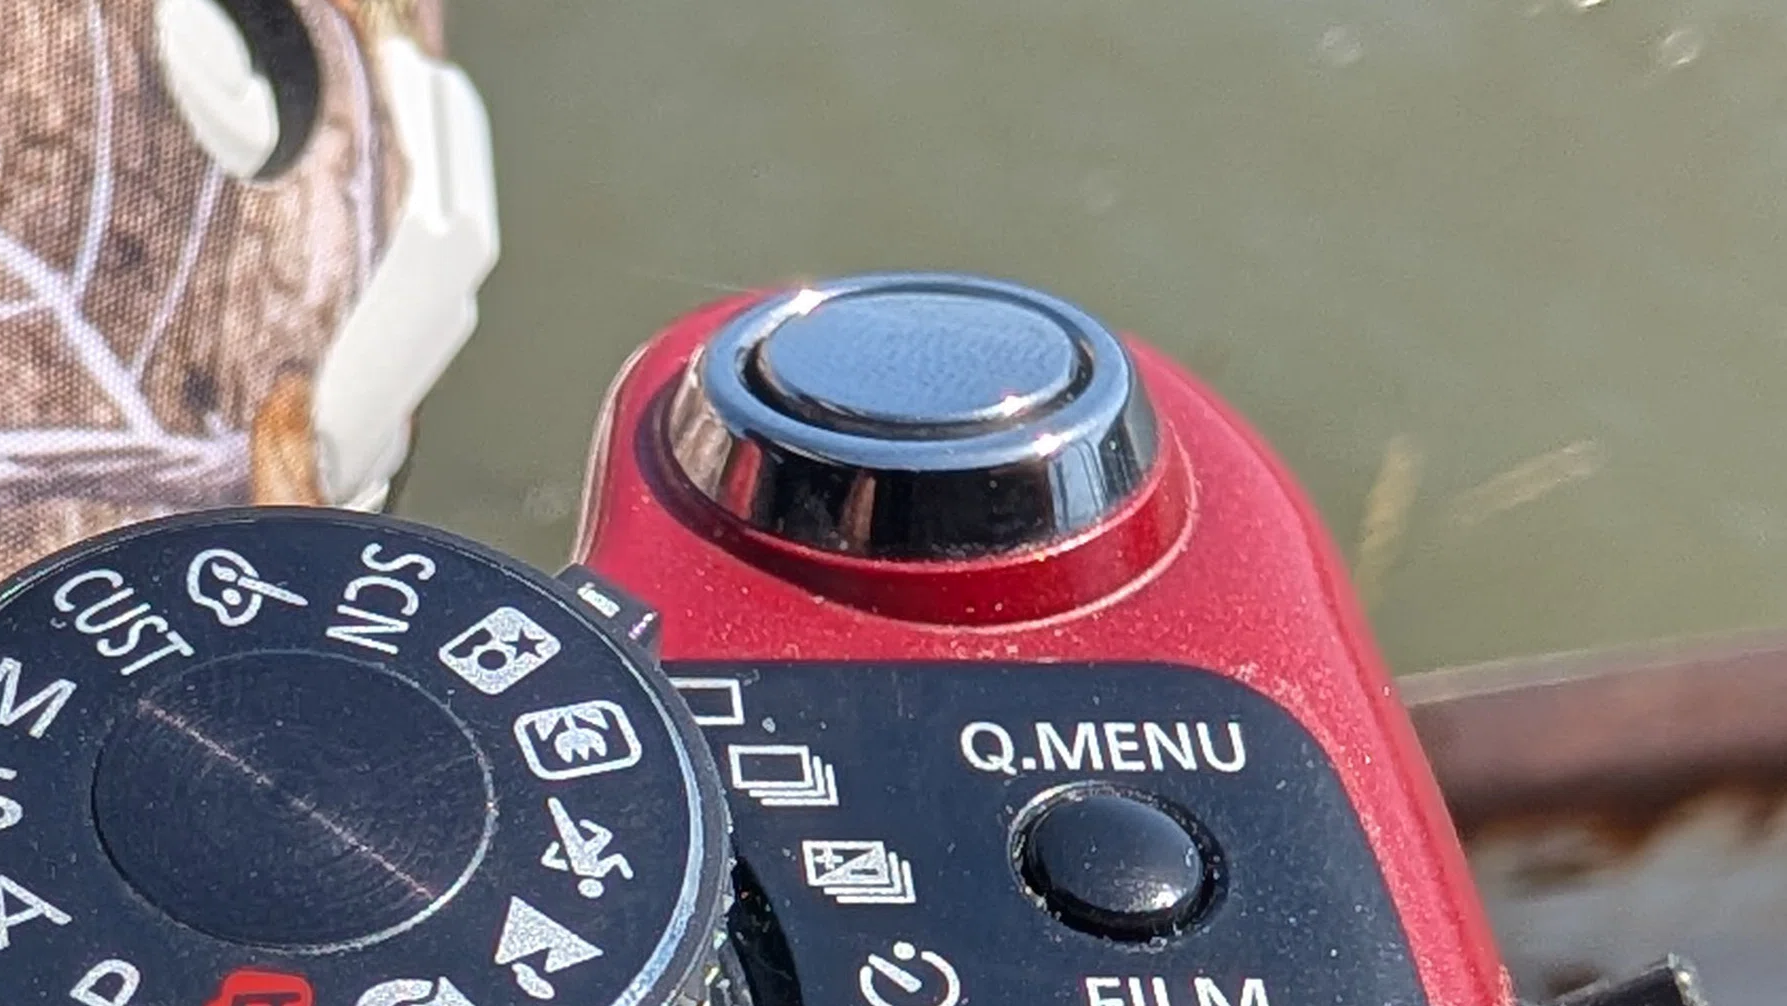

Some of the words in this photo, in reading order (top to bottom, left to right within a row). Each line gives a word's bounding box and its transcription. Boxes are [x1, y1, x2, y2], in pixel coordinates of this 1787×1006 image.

[52, 567, 194, 676] CUST
[325, 543, 436, 655] SCN
[960, 721, 1246, 775] Q.MENU
